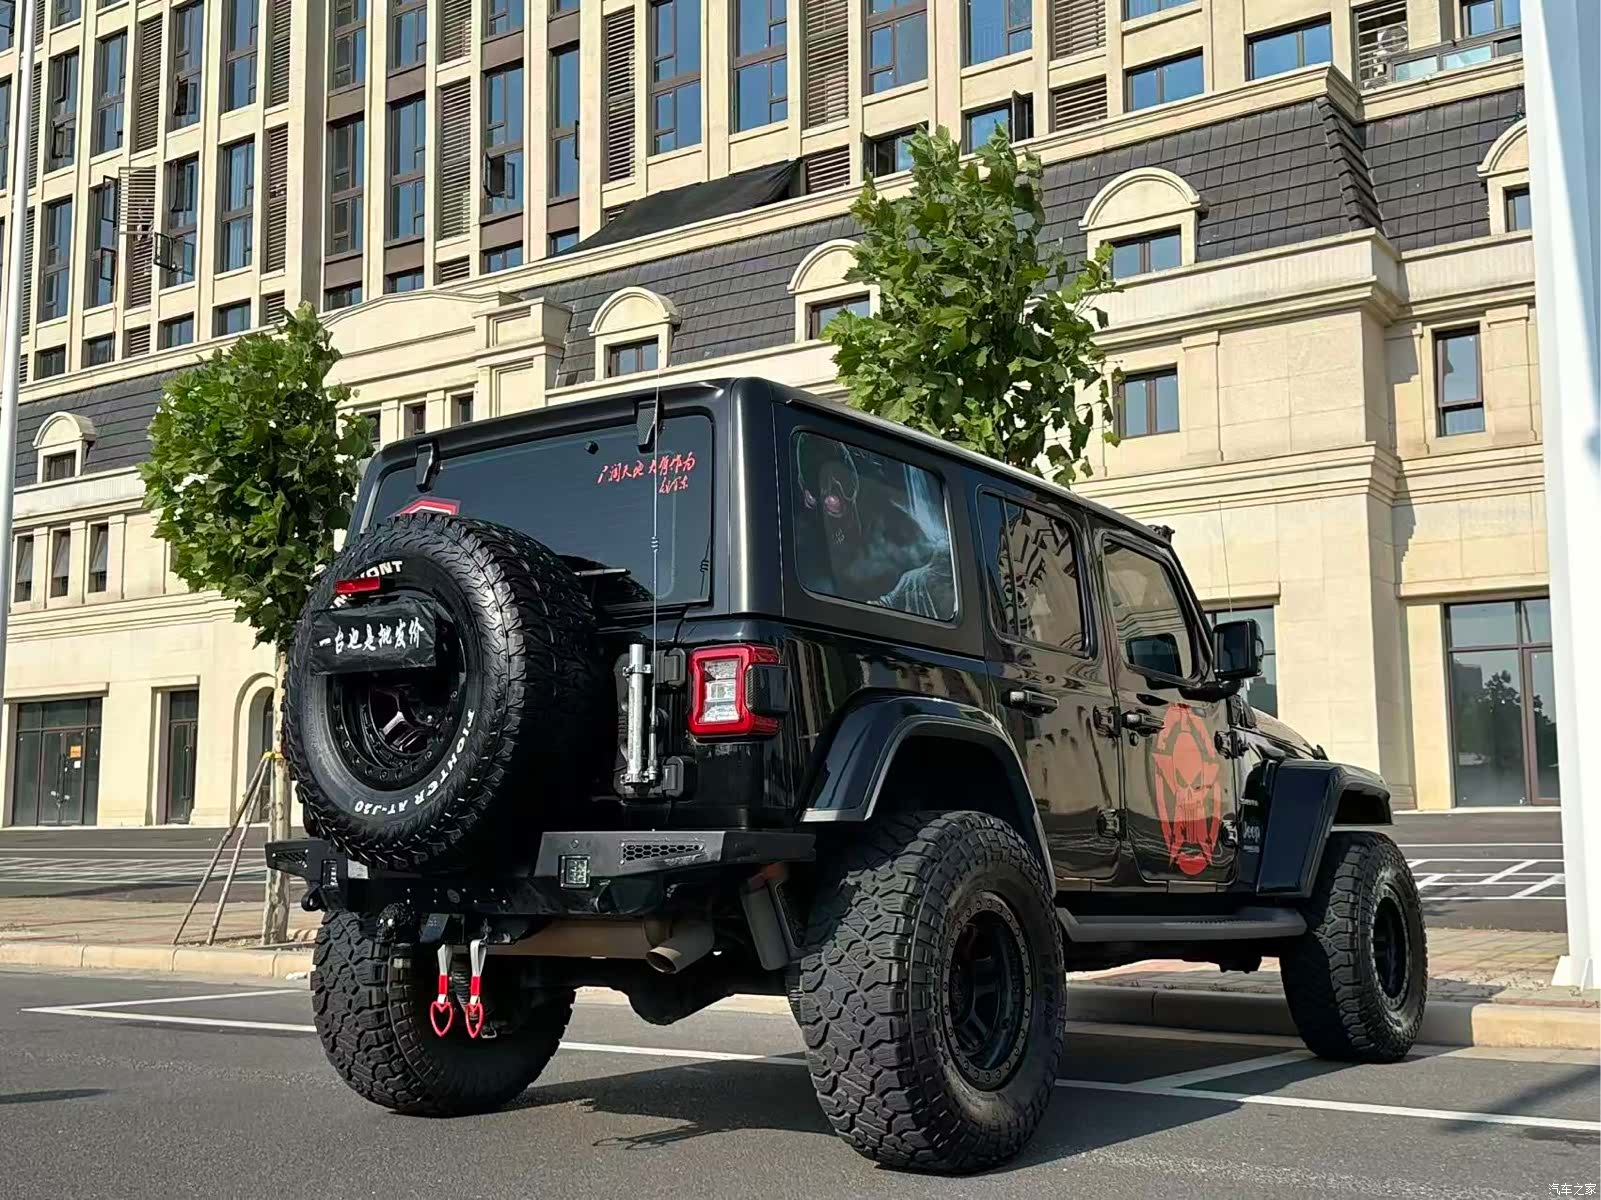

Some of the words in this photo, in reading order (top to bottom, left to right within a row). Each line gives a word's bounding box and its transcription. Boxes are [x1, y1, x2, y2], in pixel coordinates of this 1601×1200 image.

[319, 616, 425, 655] 一台也是批发价
[354, 799, 409, 815] AT-J20
[1243, 821, 1260, 843] Jeep
